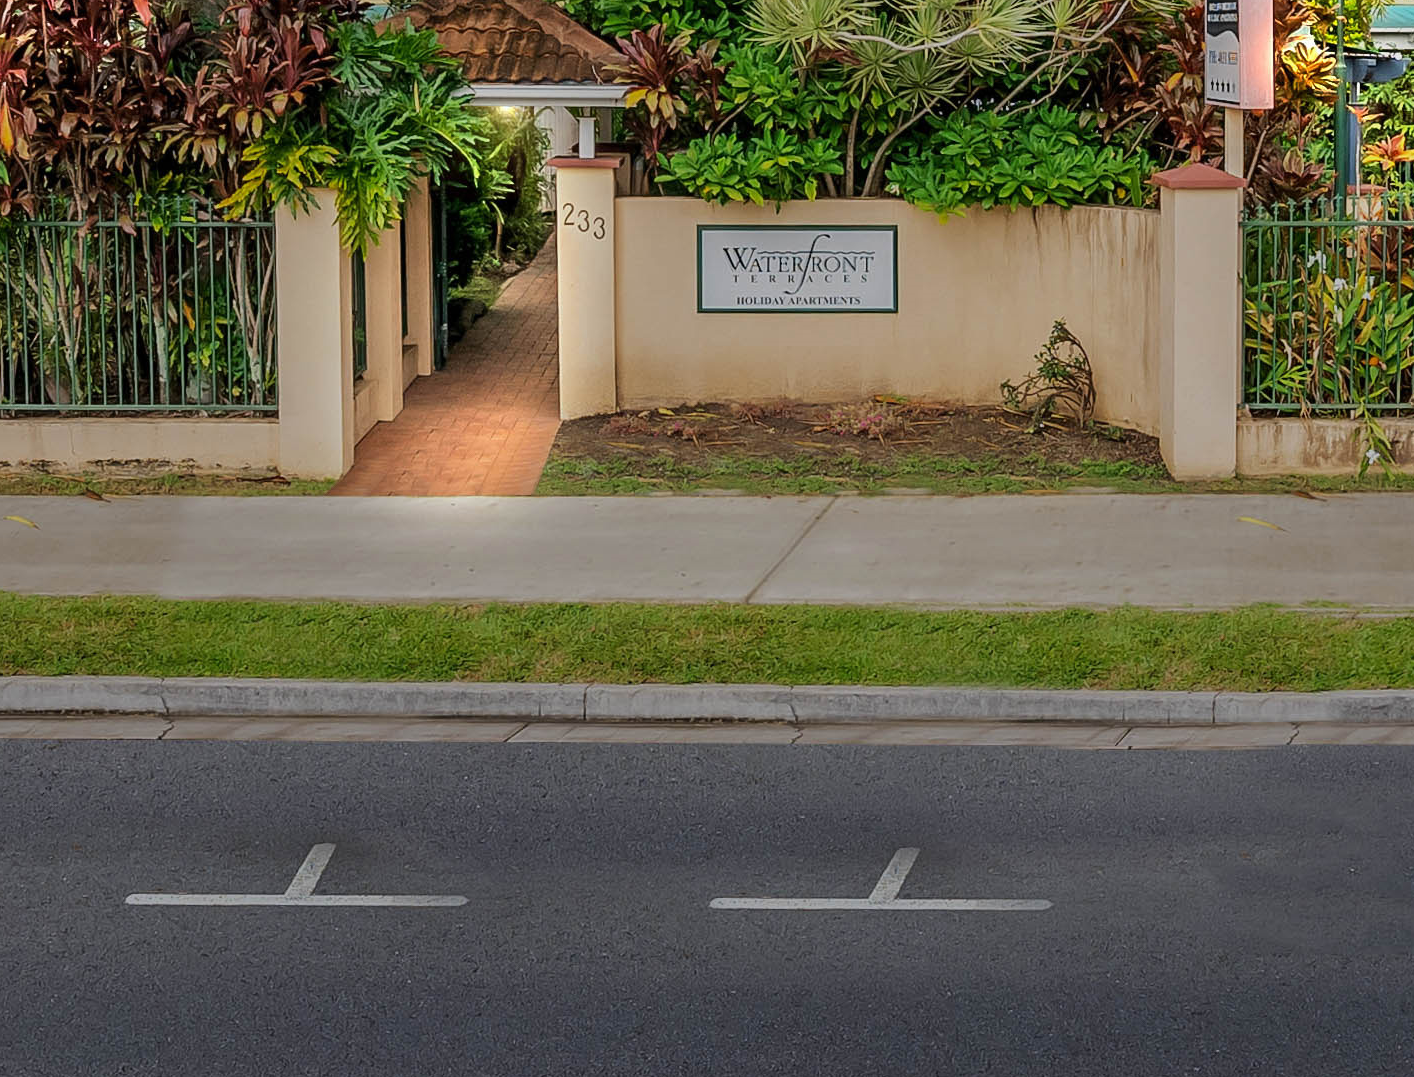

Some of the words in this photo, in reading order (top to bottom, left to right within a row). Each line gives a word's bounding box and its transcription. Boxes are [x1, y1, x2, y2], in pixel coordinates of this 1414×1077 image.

[562, 202, 606, 240] 233
[732, 274, 869, 284] TERRACES
[736, 296, 785, 306] HOLIDAY
[788, 296, 862, 306] APARTMENTS
